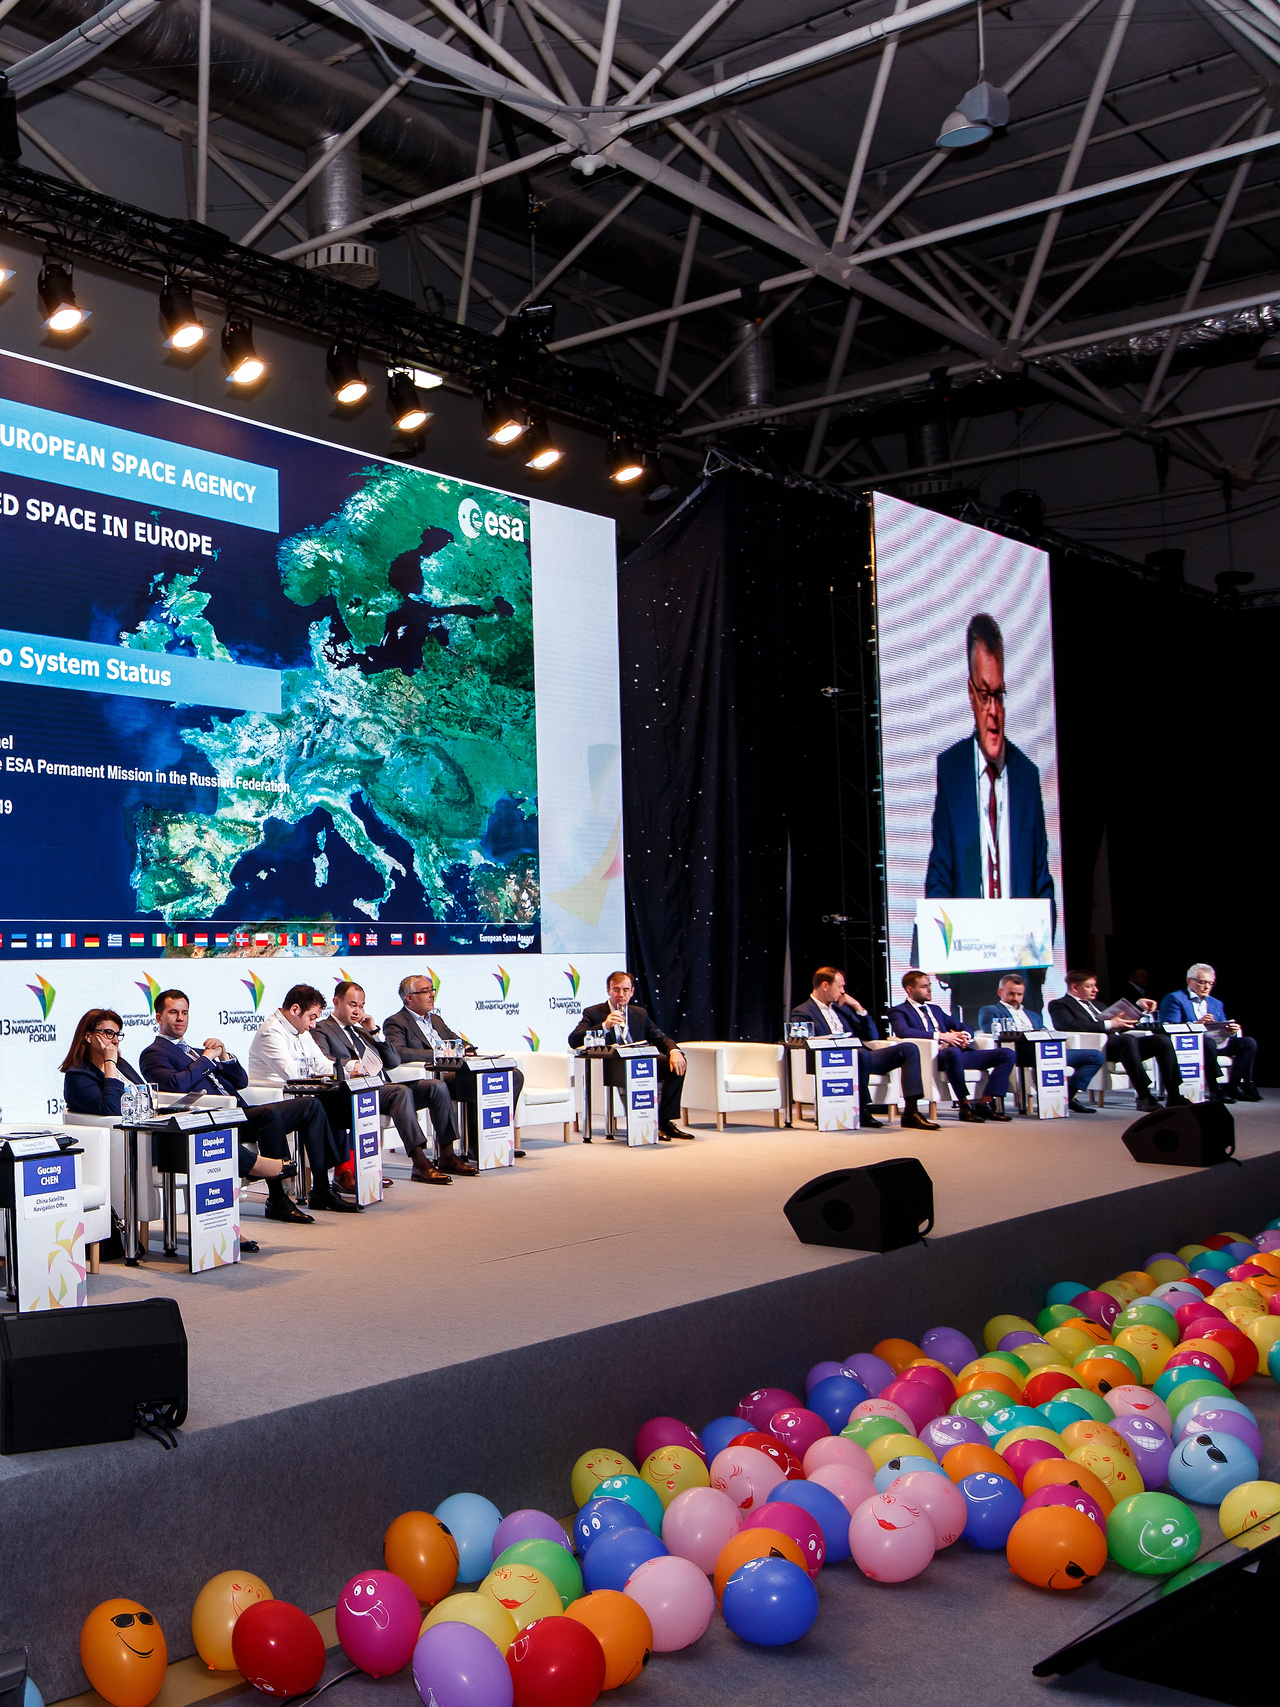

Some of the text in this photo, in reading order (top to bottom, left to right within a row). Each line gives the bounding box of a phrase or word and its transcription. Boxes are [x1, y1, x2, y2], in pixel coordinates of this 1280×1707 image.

[111, 450, 176, 485] SPACE
[181, 468, 257, 503] AGENCY
[26, 498, 97, 533] SPACE
[102, 513, 128, 539] IN
[134, 521, 213, 556] EUROPE
[484, 511, 525, 543] esa
[19, 645, 100, 677] System
[106, 658, 172, 687] Status
[5, 756, 35, 774] ESA
[37, 759, 105, 780] Permanent
[107, 764, 153, 783] Mission
[155, 768, 167, 785] in
[169, 769, 188, 787] the
[189, 771, 234, 790] Russian
[235, 775, 291, 793] Federation
[479, 933, 502, 944] European
[502, 933, 517, 944] Space
[218, 1010, 265, 1025] 13 NAVIGATION
[0, 1019, 56, 1035] 13 NAVIGATION
[29, 1033, 56, 1042] FORUM
[47, 1099, 58, 1114] 13
[37, 1165, 61, 1175] Gucang
[40, 1175, 58, 1186] CHEN
[209, 1187, 220, 1196] Рене
[33, 1202, 68, 1213] Navigation Office
[36, 1196, 65, 1205] China Satellite
